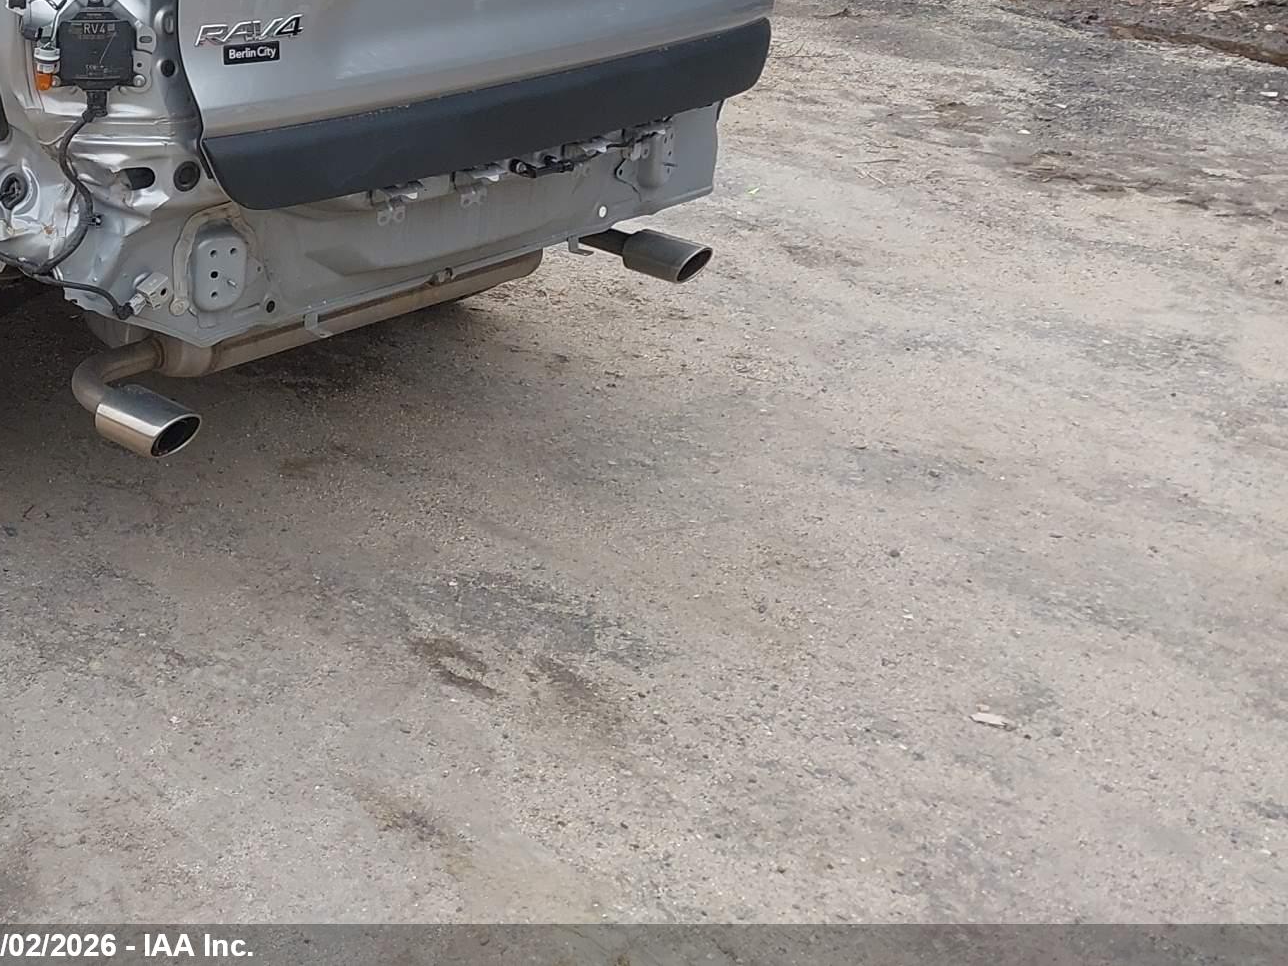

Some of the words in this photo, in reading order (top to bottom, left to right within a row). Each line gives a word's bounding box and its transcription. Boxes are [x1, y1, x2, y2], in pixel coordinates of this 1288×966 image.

[83, 23, 106, 34] RV4
[194, 13, 304, 47] RAV4
[228, 47, 257, 59] Berlin
[257, 46, 277, 59] City
